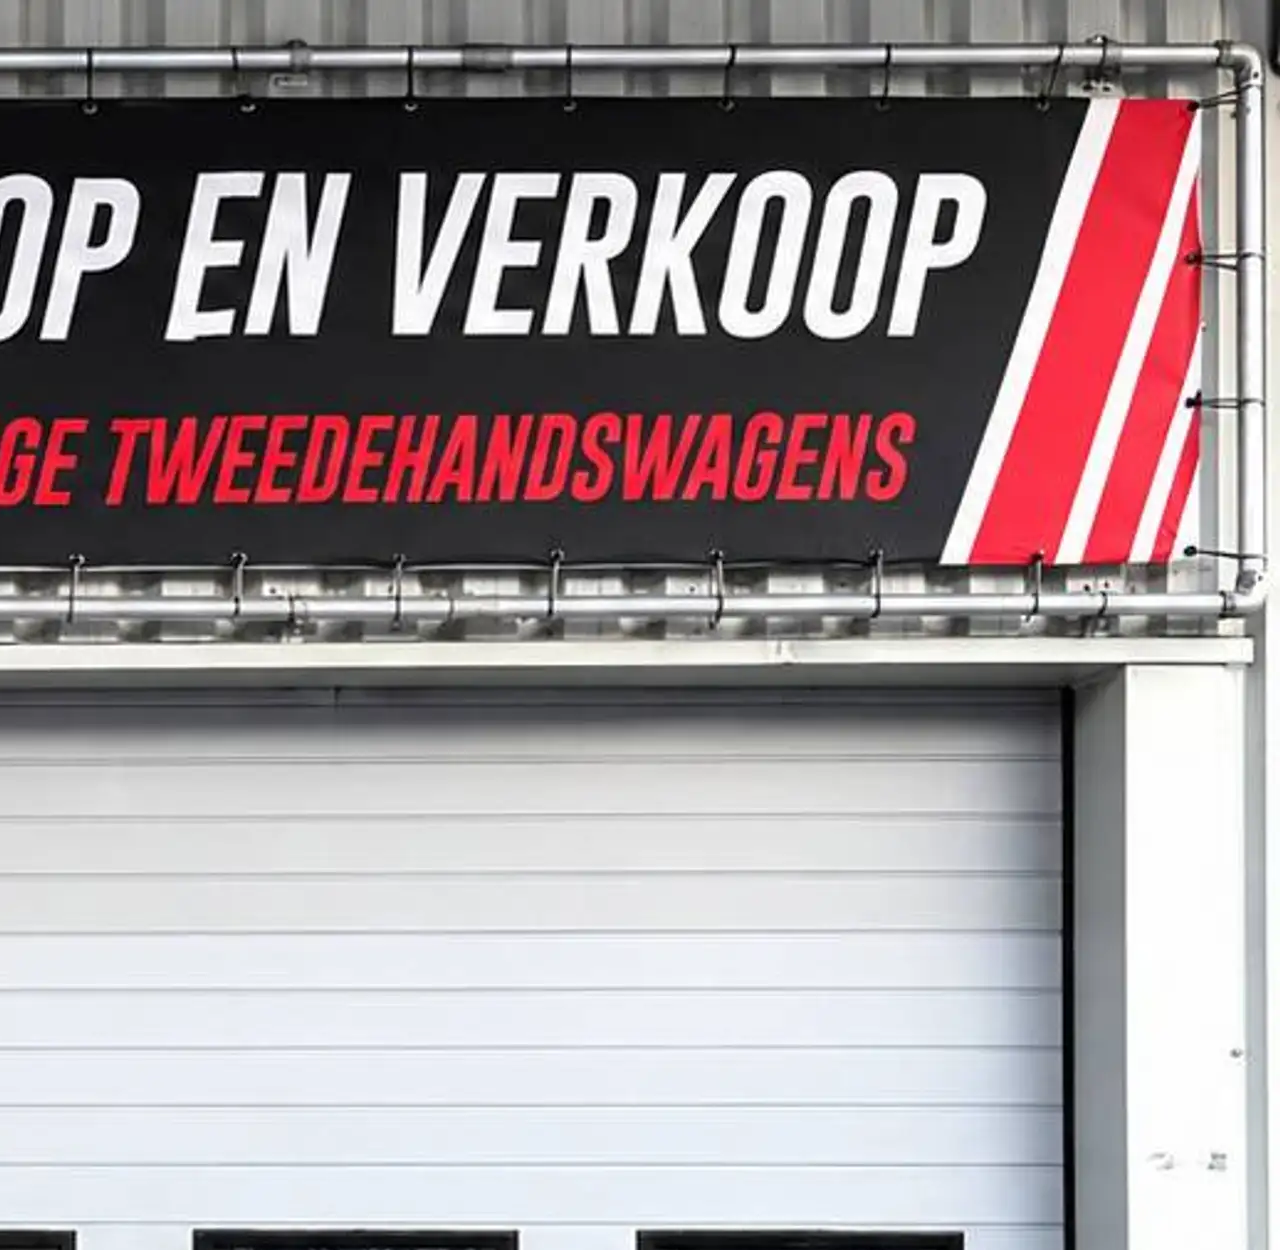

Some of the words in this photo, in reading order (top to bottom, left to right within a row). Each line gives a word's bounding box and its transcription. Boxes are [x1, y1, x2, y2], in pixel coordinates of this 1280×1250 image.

[164, 171, 352, 341] EN
[392, 170, 987, 340] VERKOOP
[105, 410, 918, 508] TWEEDEHANDSWAGENS
